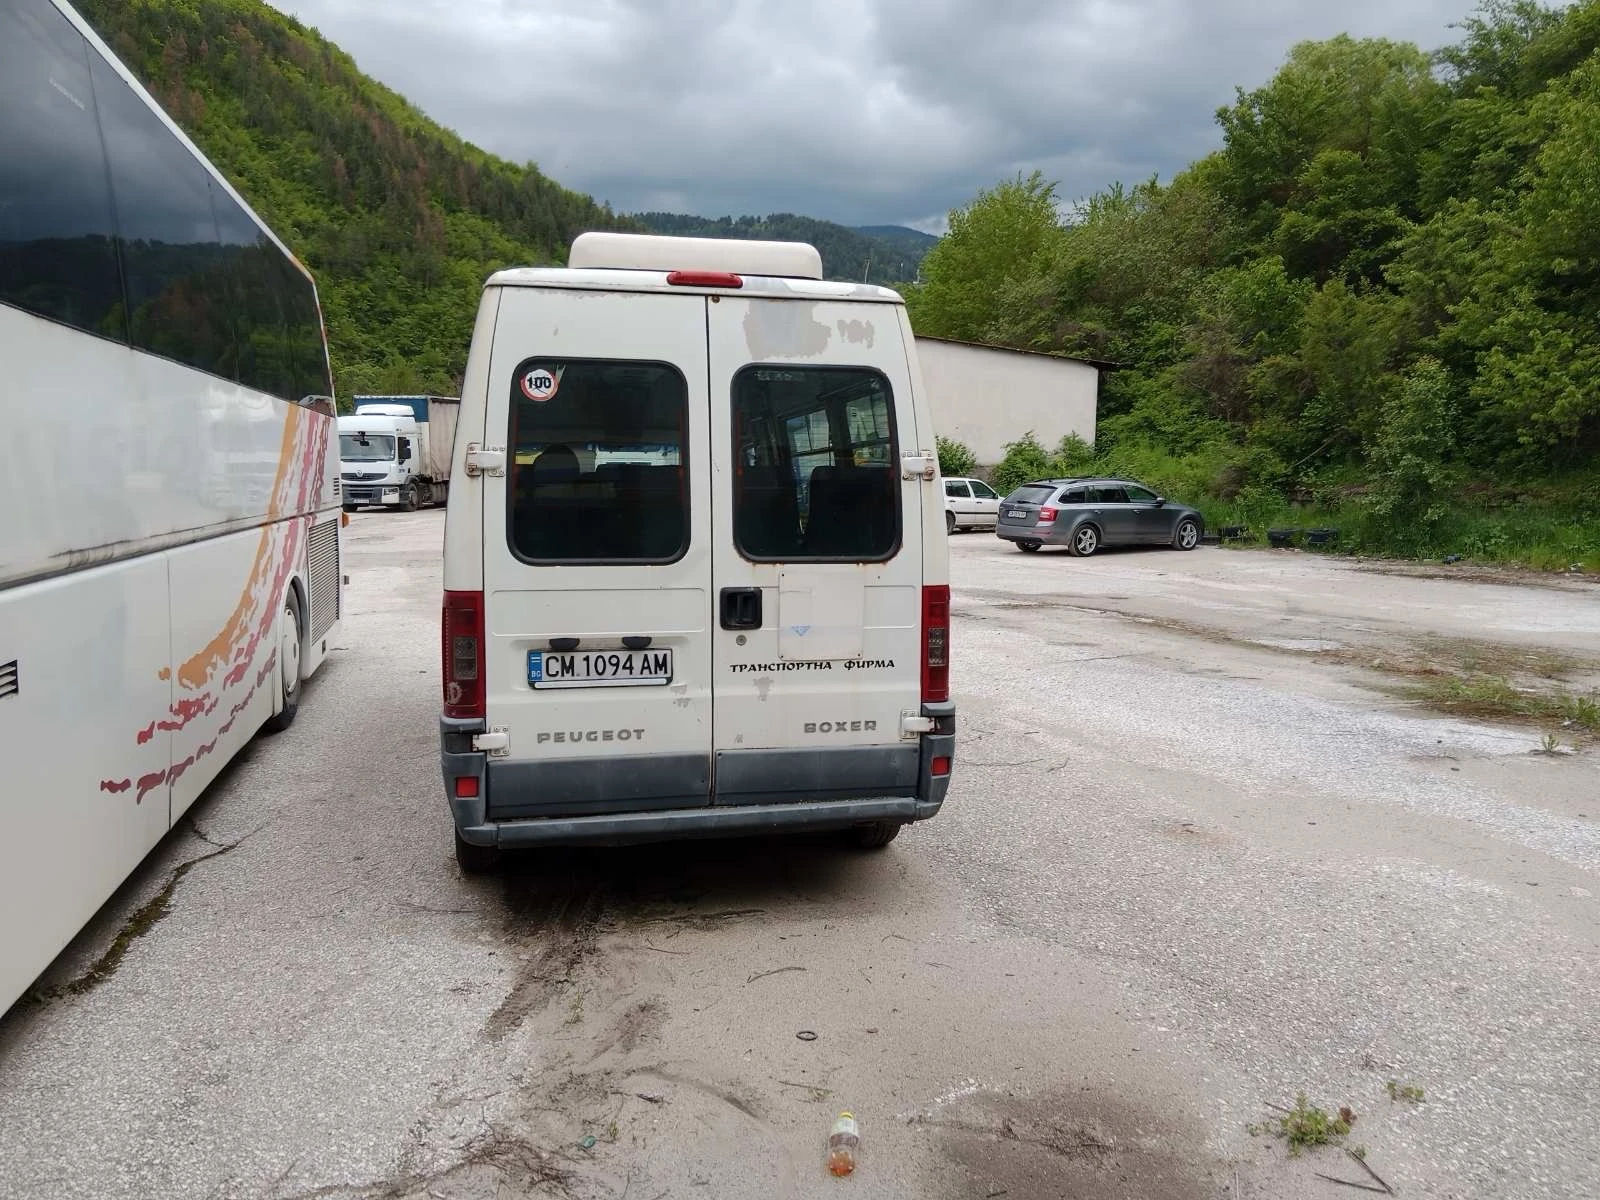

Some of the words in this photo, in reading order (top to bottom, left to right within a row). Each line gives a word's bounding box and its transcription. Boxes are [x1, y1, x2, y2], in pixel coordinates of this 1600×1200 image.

[527, 376, 551, 389] 100
[545, 655, 575, 677] CM
[583, 654, 633, 676] 1094
[640, 653, 667, 675] AM
[730, 661, 832, 672] ТРАНСПОРТНА
[844, 659, 895, 671] ФИРМА
[531, 670, 541, 678] BG
[804, 720, 877, 733] BOXER
[537, 729, 645, 744] PEUGEOT
